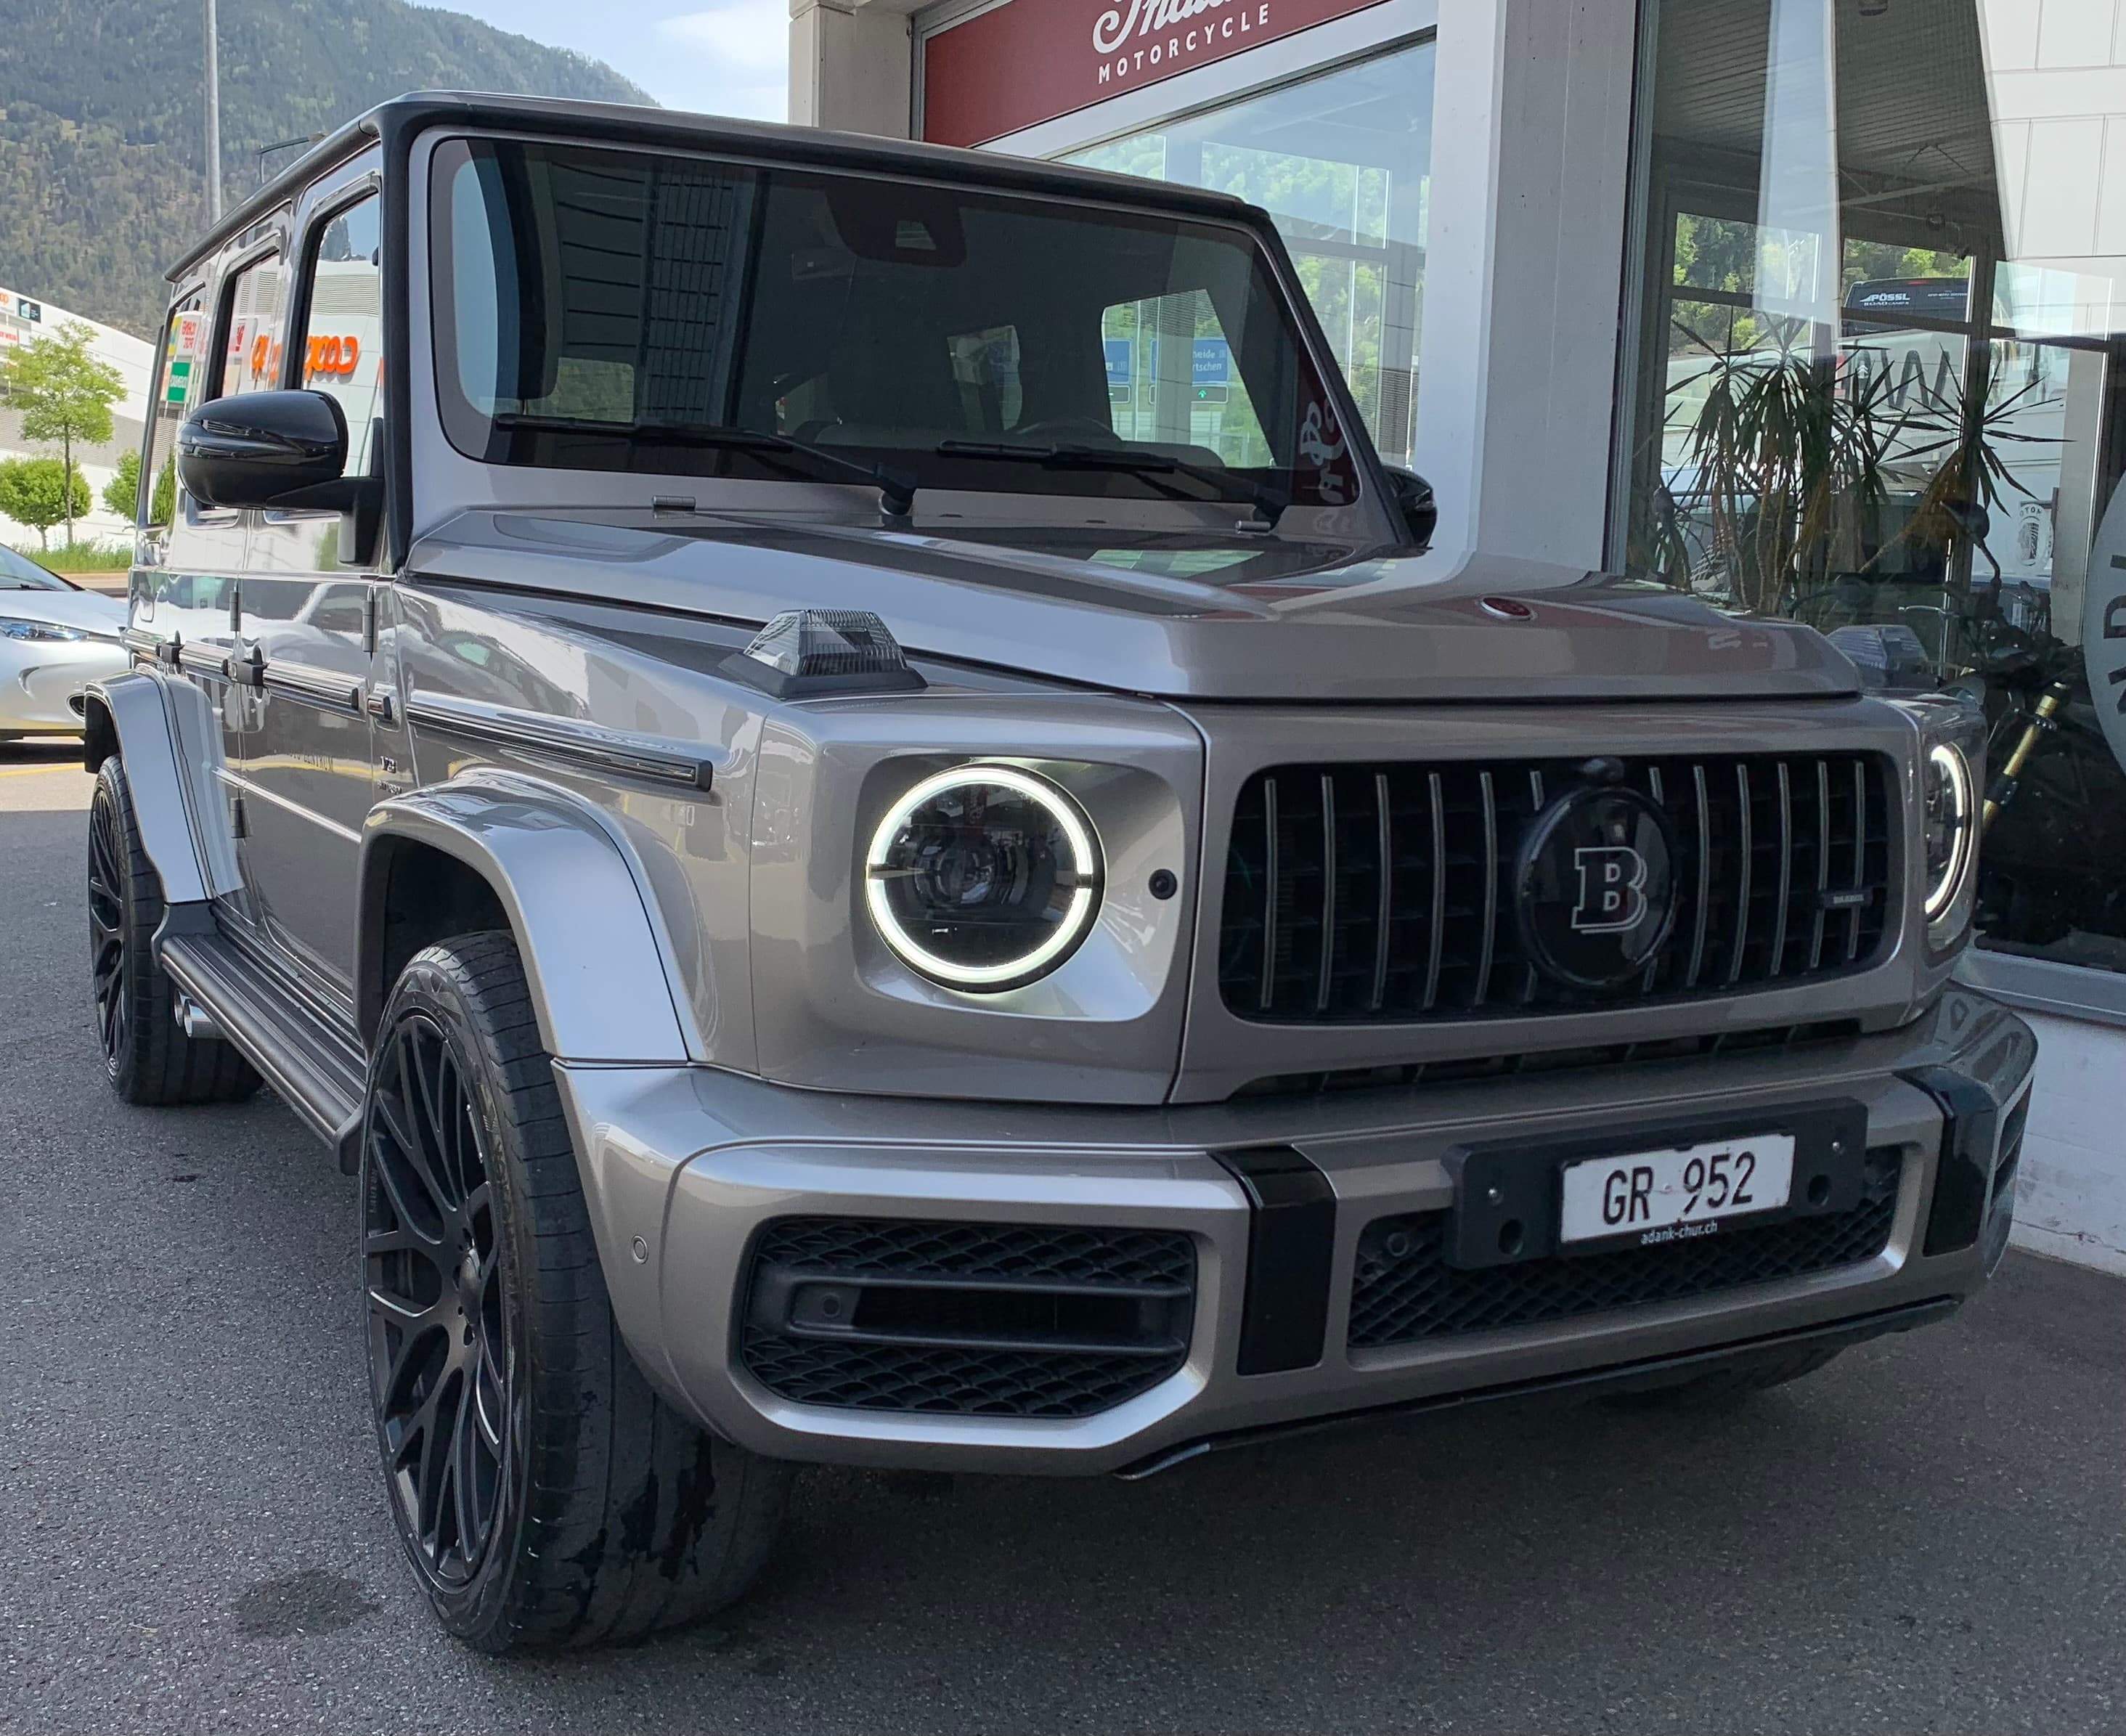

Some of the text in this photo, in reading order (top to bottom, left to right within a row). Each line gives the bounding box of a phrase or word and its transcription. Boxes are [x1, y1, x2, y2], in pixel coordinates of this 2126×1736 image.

[1099, 4, 1268, 84] MOTORCYCLE
[1870, 293, 1910, 302] PÖSSL
[1571, 846, 1648, 934] B
[1603, 1151, 1756, 1225] GR 952
[1640, 1220, 1718, 1244] adank-chur.ch
